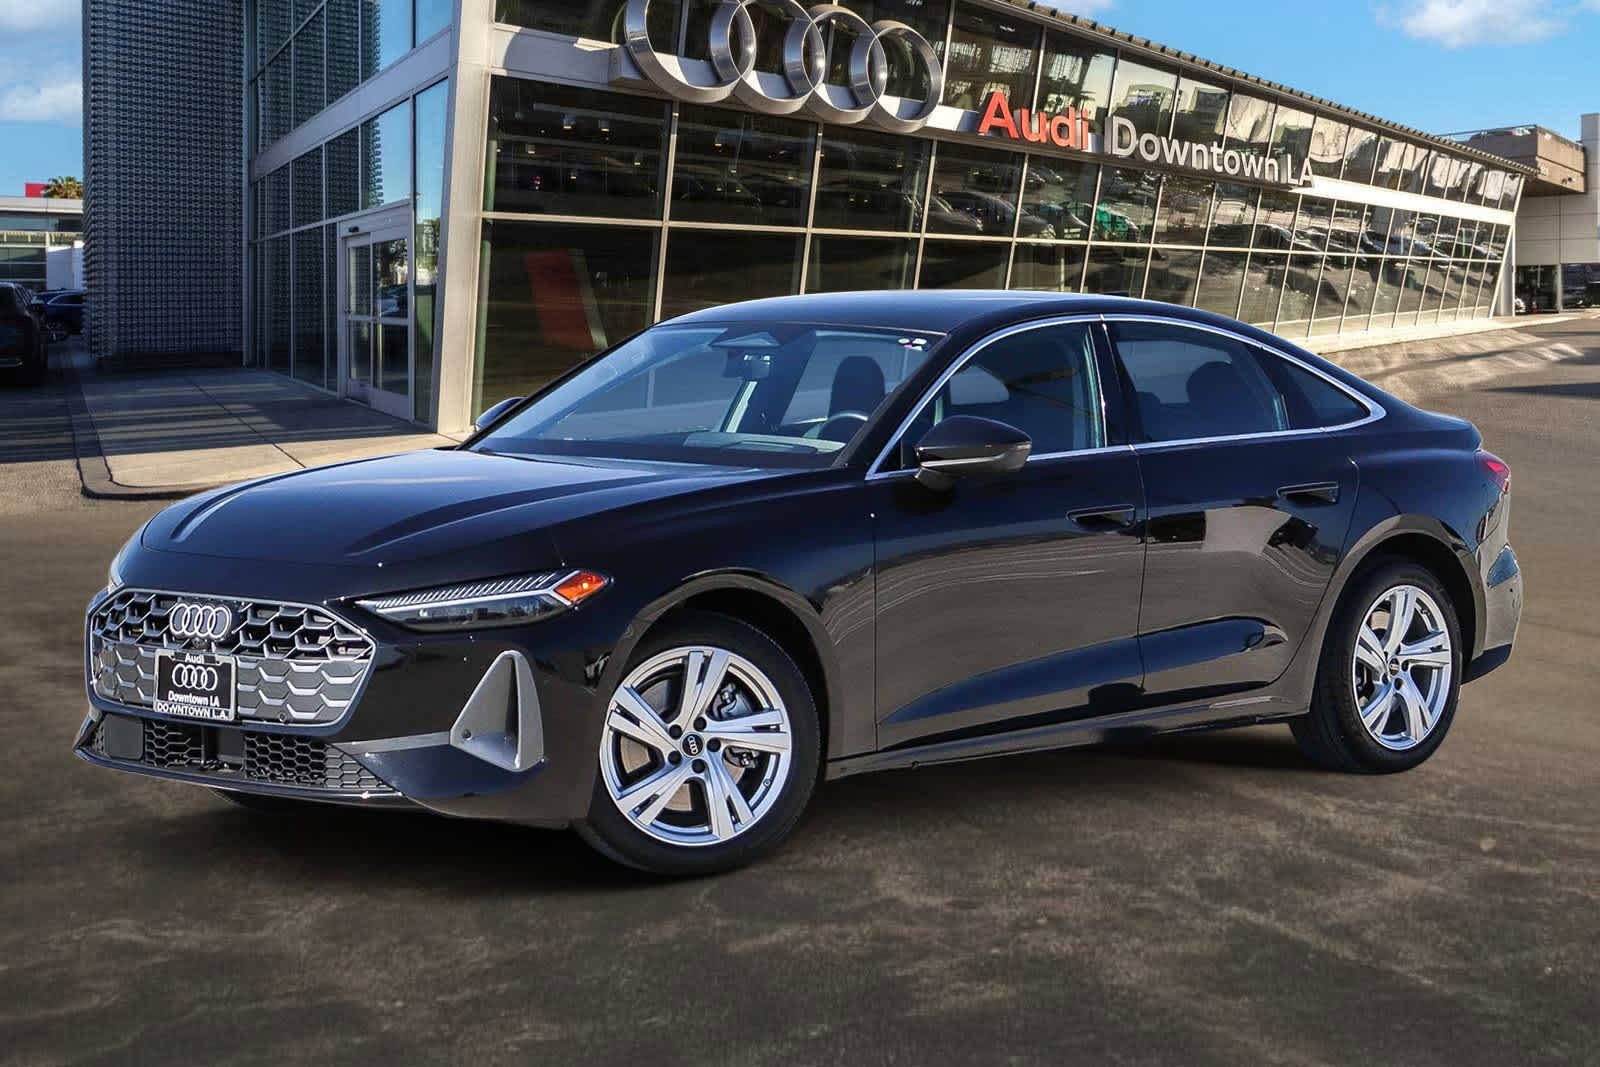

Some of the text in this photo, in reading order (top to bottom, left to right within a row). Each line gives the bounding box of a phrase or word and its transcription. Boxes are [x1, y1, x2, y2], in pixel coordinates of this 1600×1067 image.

[978, 91, 1315, 188] Audi Downtown LA
[185, 653, 204, 663] Audi
[168, 691, 219, 707] Downtown LA
[157, 703, 210, 718] DOWNTOWN
